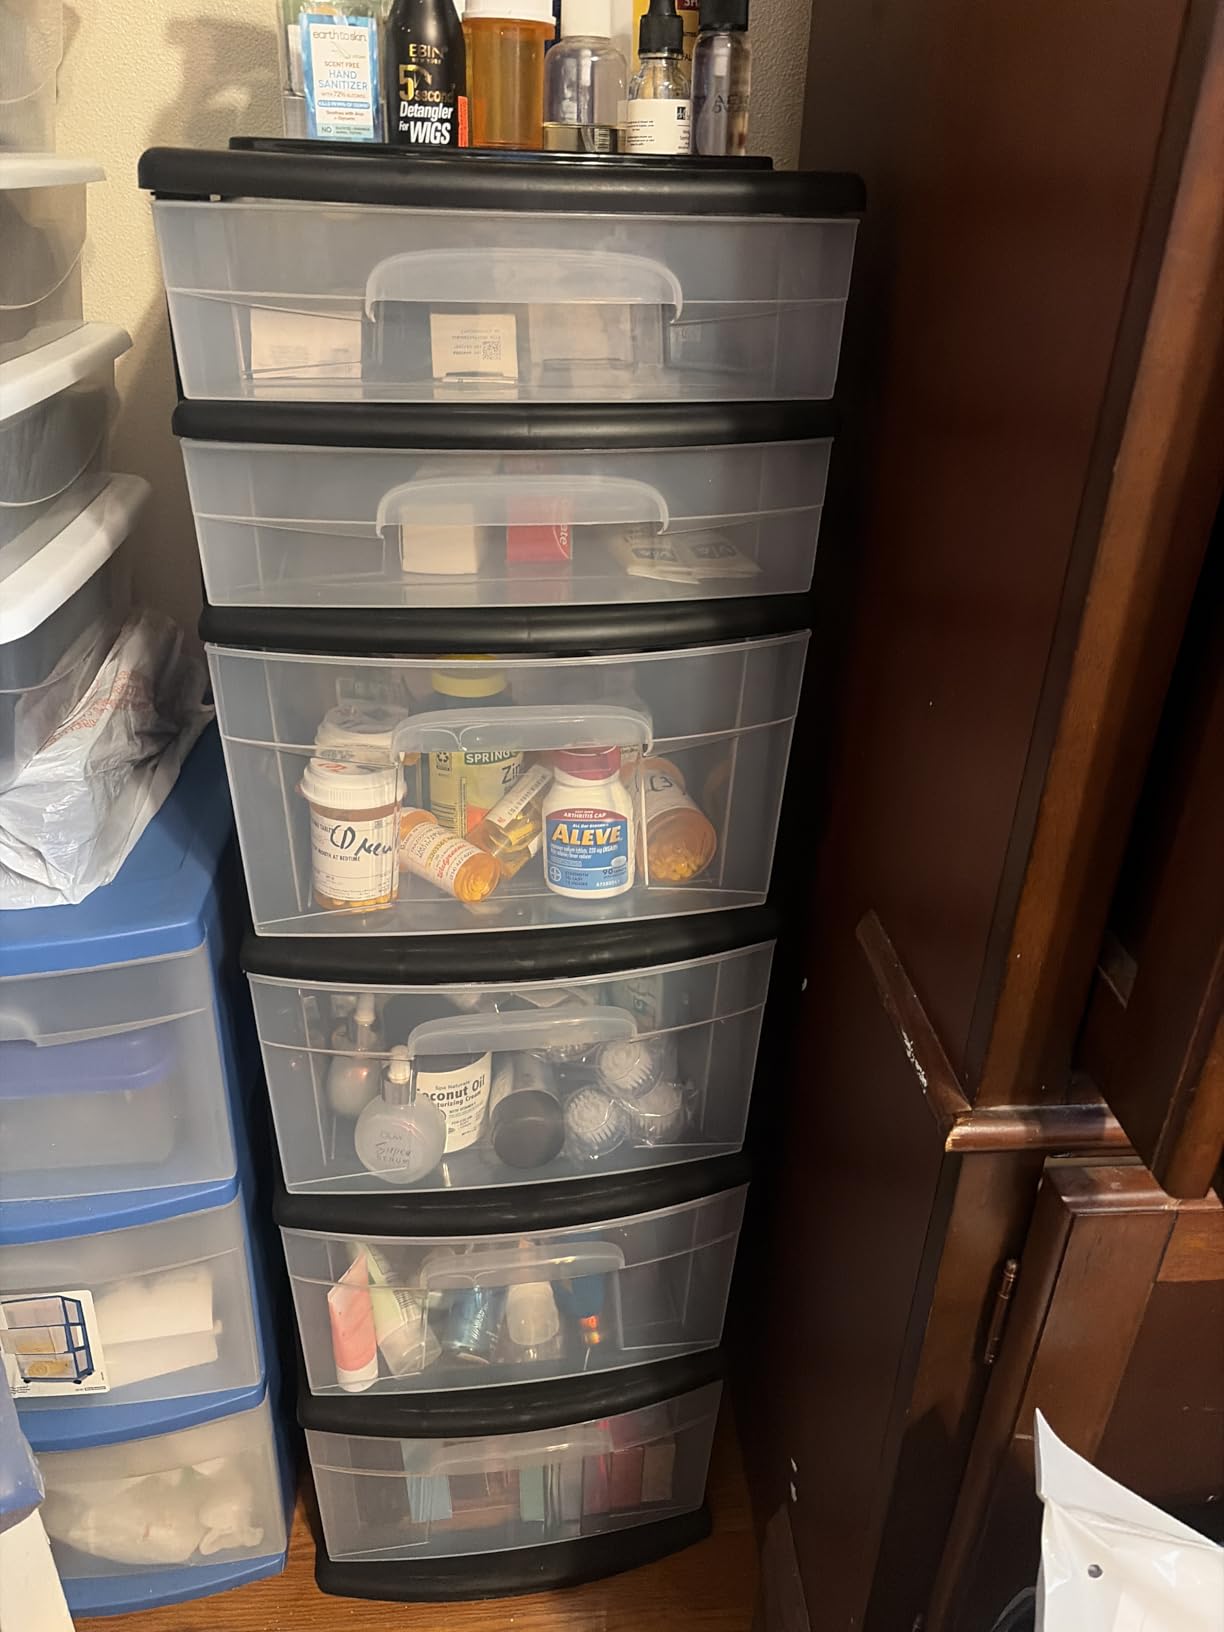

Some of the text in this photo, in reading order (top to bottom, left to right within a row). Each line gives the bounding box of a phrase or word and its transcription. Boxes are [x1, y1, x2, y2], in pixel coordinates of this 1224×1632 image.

[409, 43, 444, 58] EBIN
[329, 70, 357, 79] HAND
[318, 81, 368, 91] SANITIZER
[400, 101, 454, 122] Detangler
[399, 120, 409, 131] For
[409, 121, 452, 145] WIGS
[466, 751, 511, 764] SPRING
[501, 763, 521, 784] Zin
[552, 823, 621, 846] ALEVE
[420, 1074, 486, 1101] conut Oil
[437, 1099, 464, 1108] turizing
